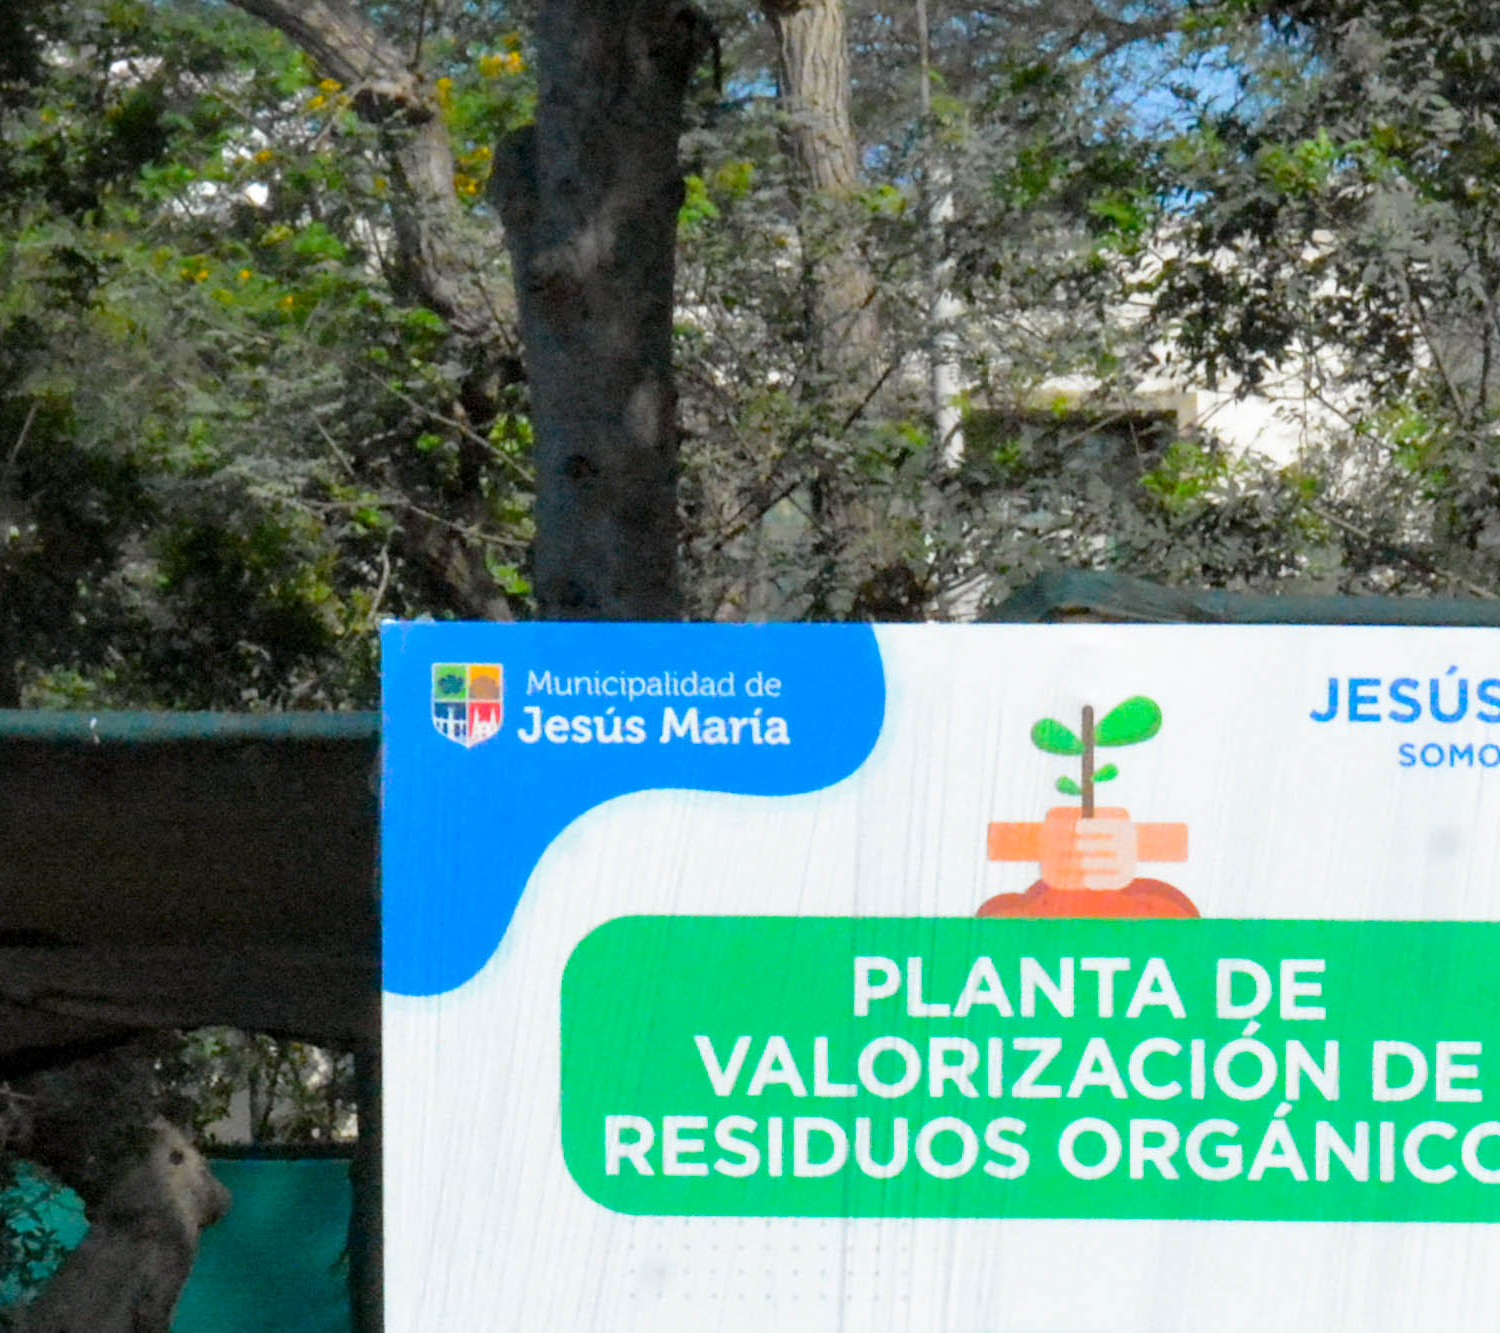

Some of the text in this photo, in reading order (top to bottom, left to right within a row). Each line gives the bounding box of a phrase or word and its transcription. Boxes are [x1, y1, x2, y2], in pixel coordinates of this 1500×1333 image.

[526, 670, 781, 701] Municipalidad de
[518, 706, 790, 745] Jesús María
[853, 956, 1327, 1020] PLANTA DE
[695, 1022, 1483, 1103] VALORIZACIÓN DE
[604, 1114, 1030, 1179] RESIDUOS
